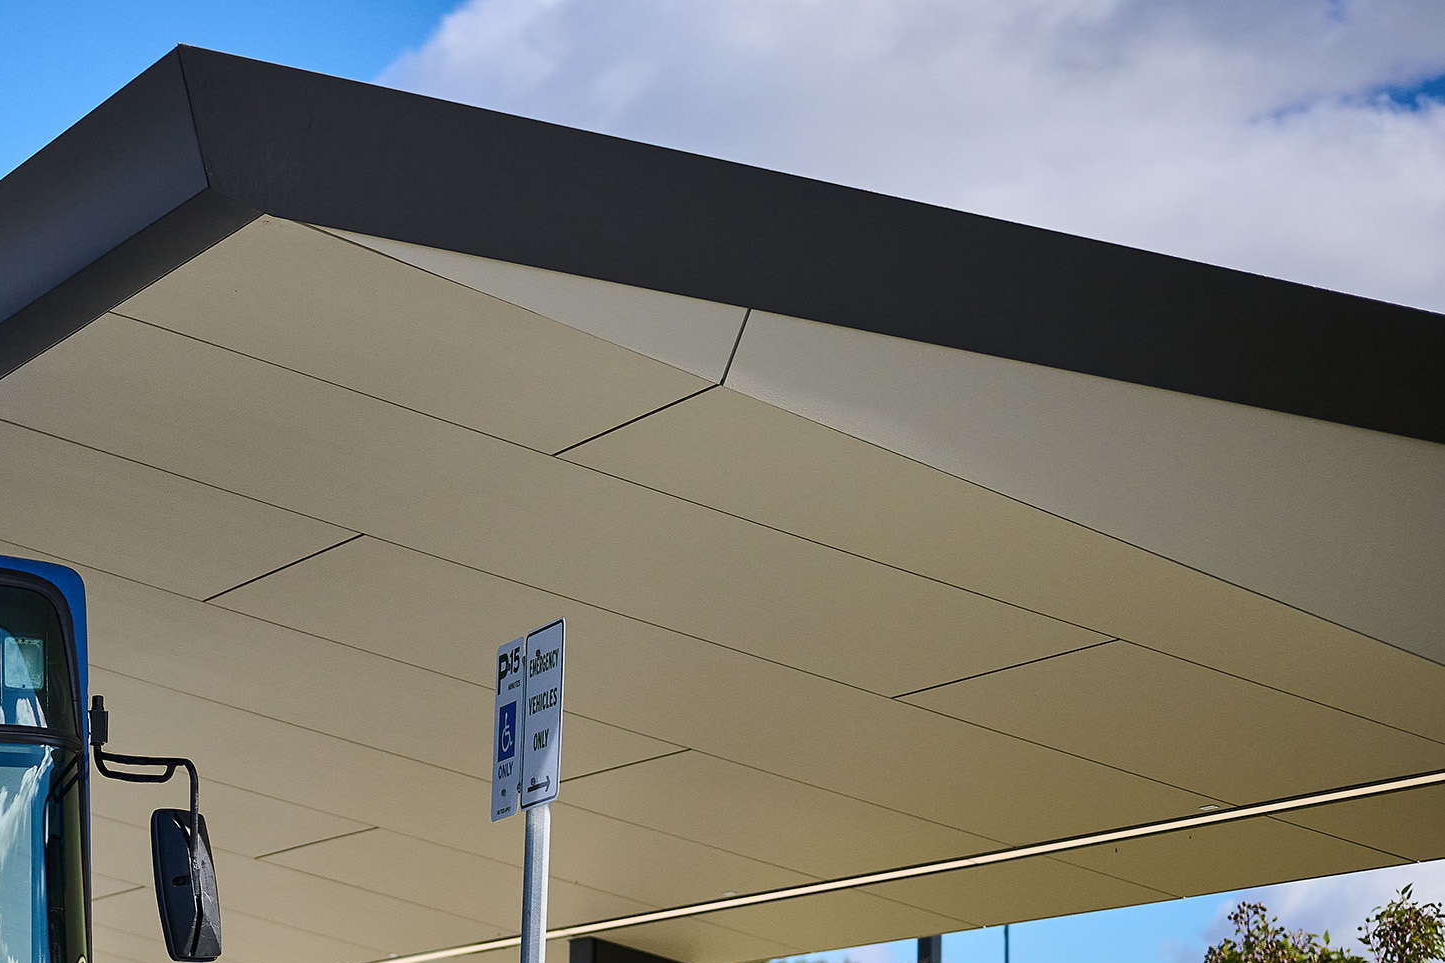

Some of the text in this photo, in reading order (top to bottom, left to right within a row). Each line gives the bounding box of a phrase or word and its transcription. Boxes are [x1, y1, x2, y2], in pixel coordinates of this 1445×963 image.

[529, 648, 560, 679] EMERGENCY
[528, 687, 558, 716] VEHICLES
[533, 728, 550, 752] ONLY
[497, 760, 514, 780] ONLY
